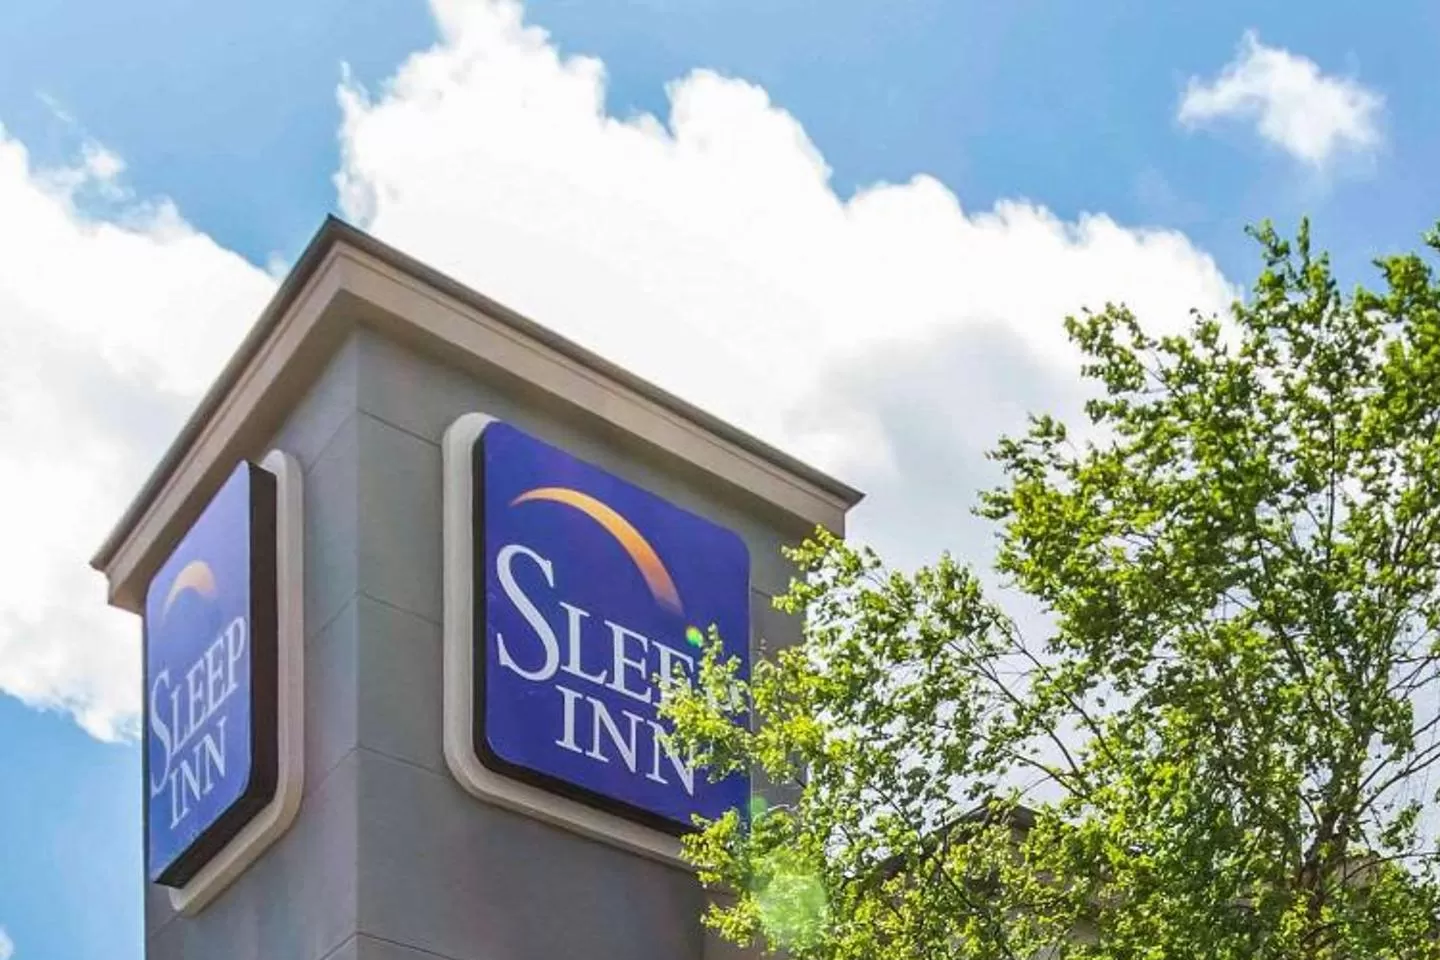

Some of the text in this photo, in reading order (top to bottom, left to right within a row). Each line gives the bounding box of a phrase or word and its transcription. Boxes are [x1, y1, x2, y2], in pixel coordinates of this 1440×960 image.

[151, 616, 246, 798] SLEEP
[556, 684, 696, 797] INN
[170, 716, 227, 829] INN
